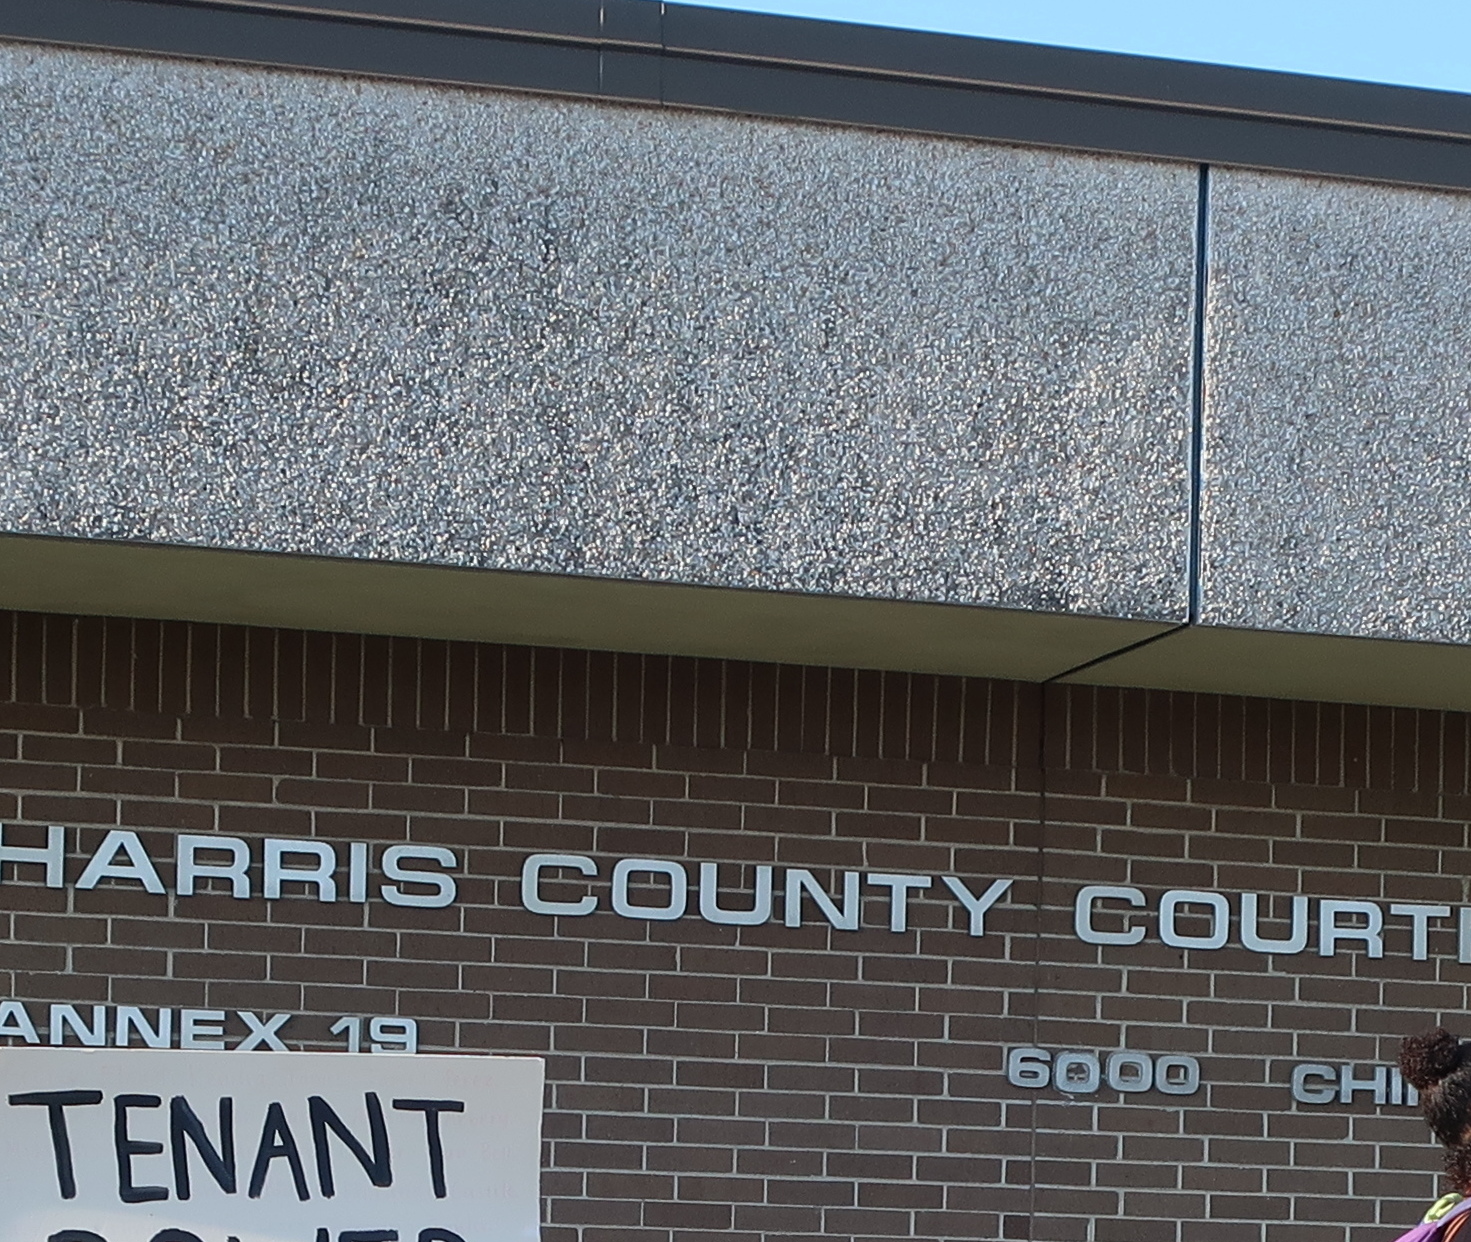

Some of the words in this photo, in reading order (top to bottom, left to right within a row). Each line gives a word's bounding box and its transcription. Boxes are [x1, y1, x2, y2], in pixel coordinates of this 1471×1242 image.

[521, 854, 1014, 937] COUNTY
[330, 1016, 417, 1053] 19
[1008, 1047, 1200, 1095] 6000
[8, 1090, 464, 1203] TENANT
